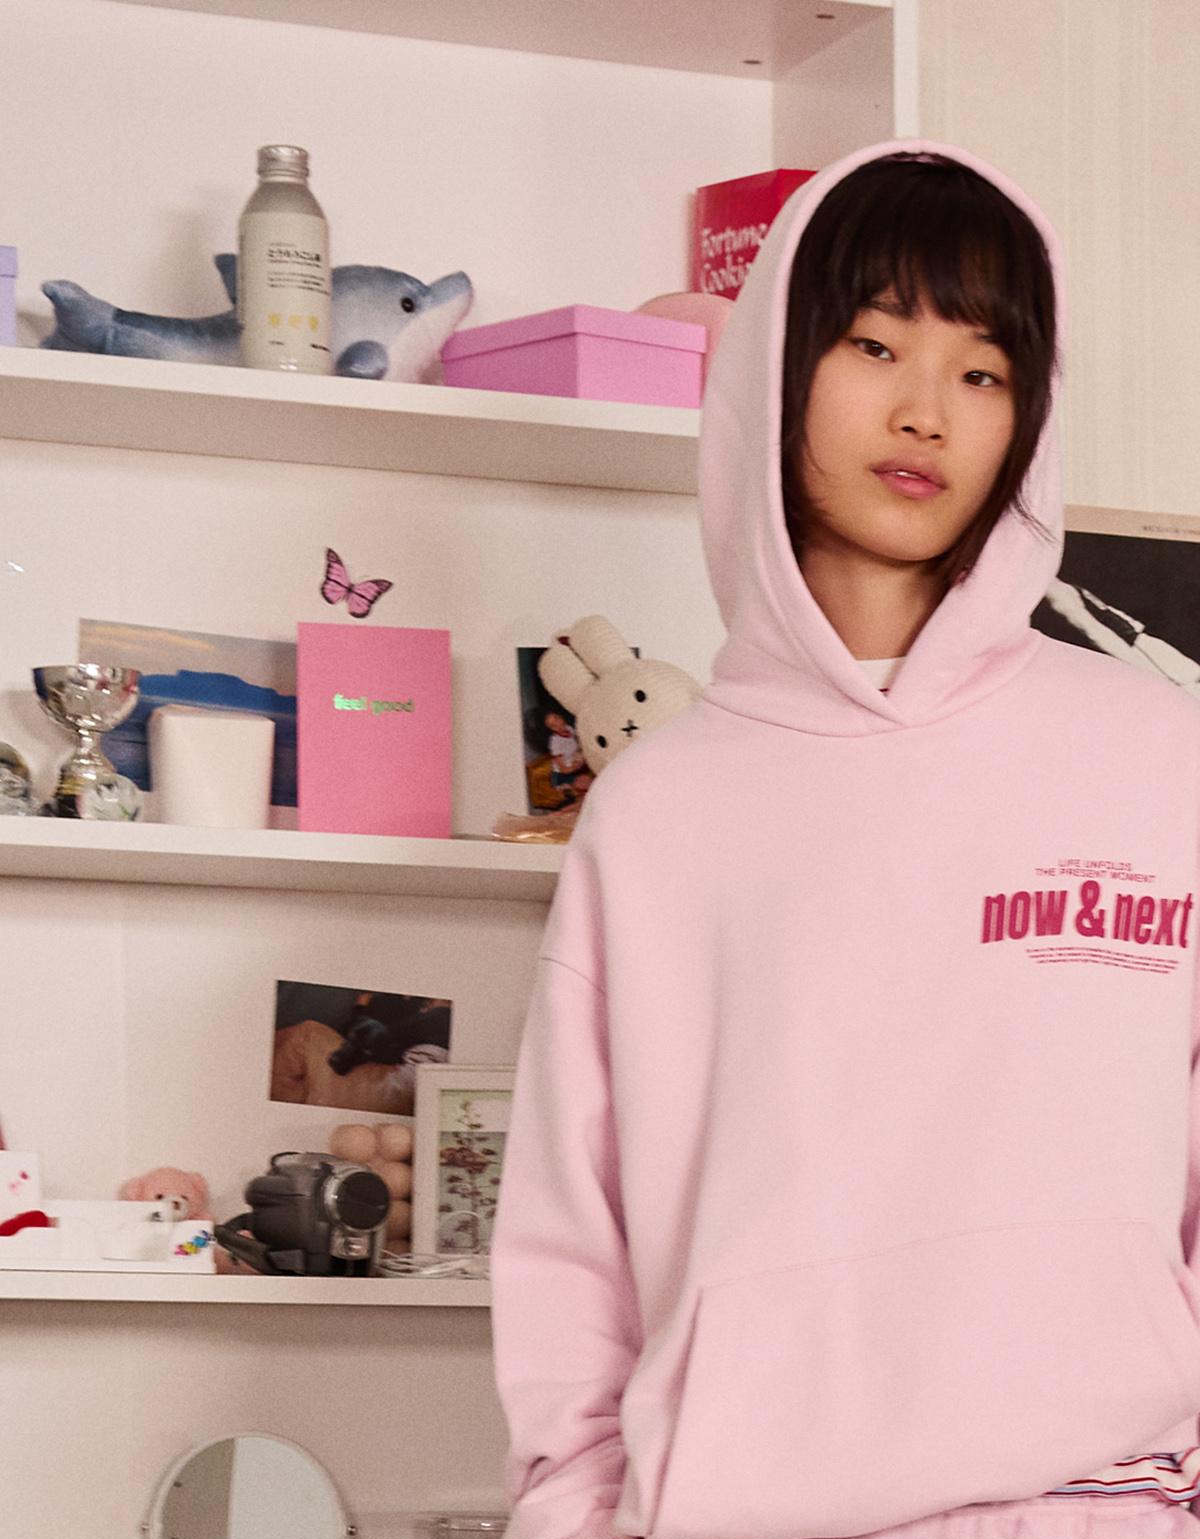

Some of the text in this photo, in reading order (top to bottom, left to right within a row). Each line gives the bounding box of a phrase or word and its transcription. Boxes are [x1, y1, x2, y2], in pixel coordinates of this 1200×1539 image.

[332, 692, 416, 716] feel good
[1034, 866, 1056, 877] THE
[1058, 867, 1108, 880] PRESENT
[981, 880, 1195, 949] now & next
